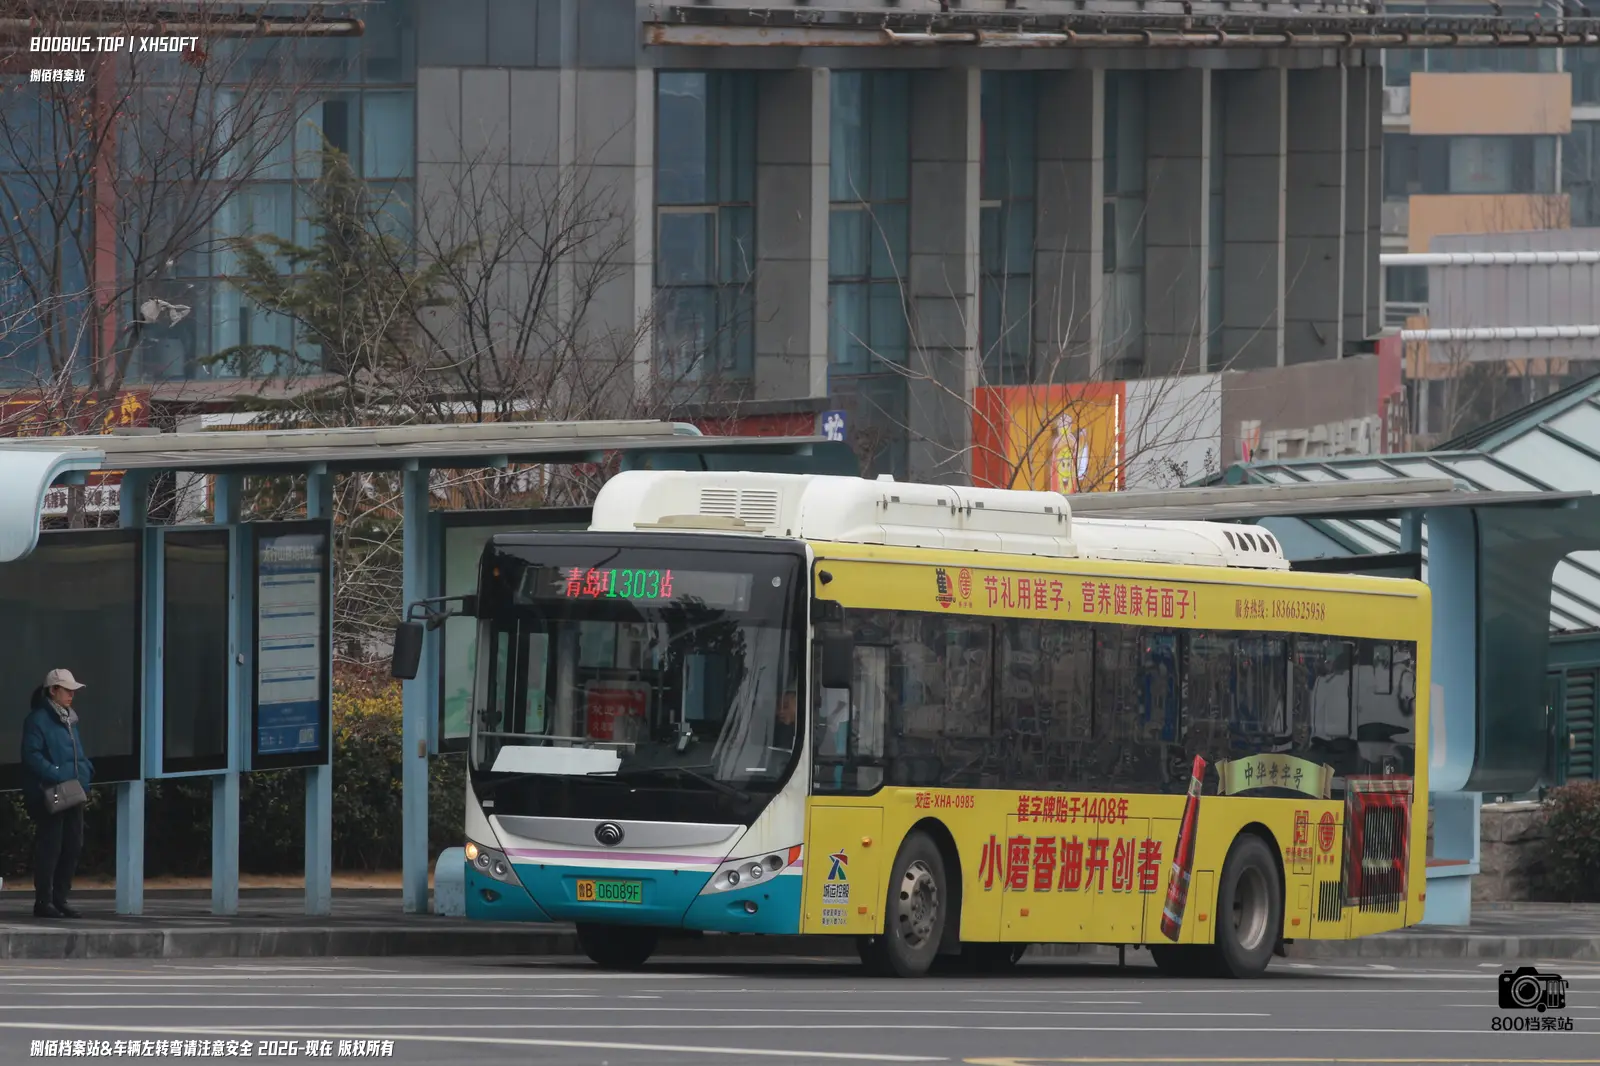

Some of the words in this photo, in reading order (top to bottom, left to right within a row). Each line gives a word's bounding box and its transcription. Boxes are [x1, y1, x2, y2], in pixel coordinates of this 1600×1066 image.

[1244, 762, 1304, 790] 中华老字号
[1018, 794, 1129, 824] 崔字牌始于1408年
[978, 834, 1163, 894] 小磨香油开创者
